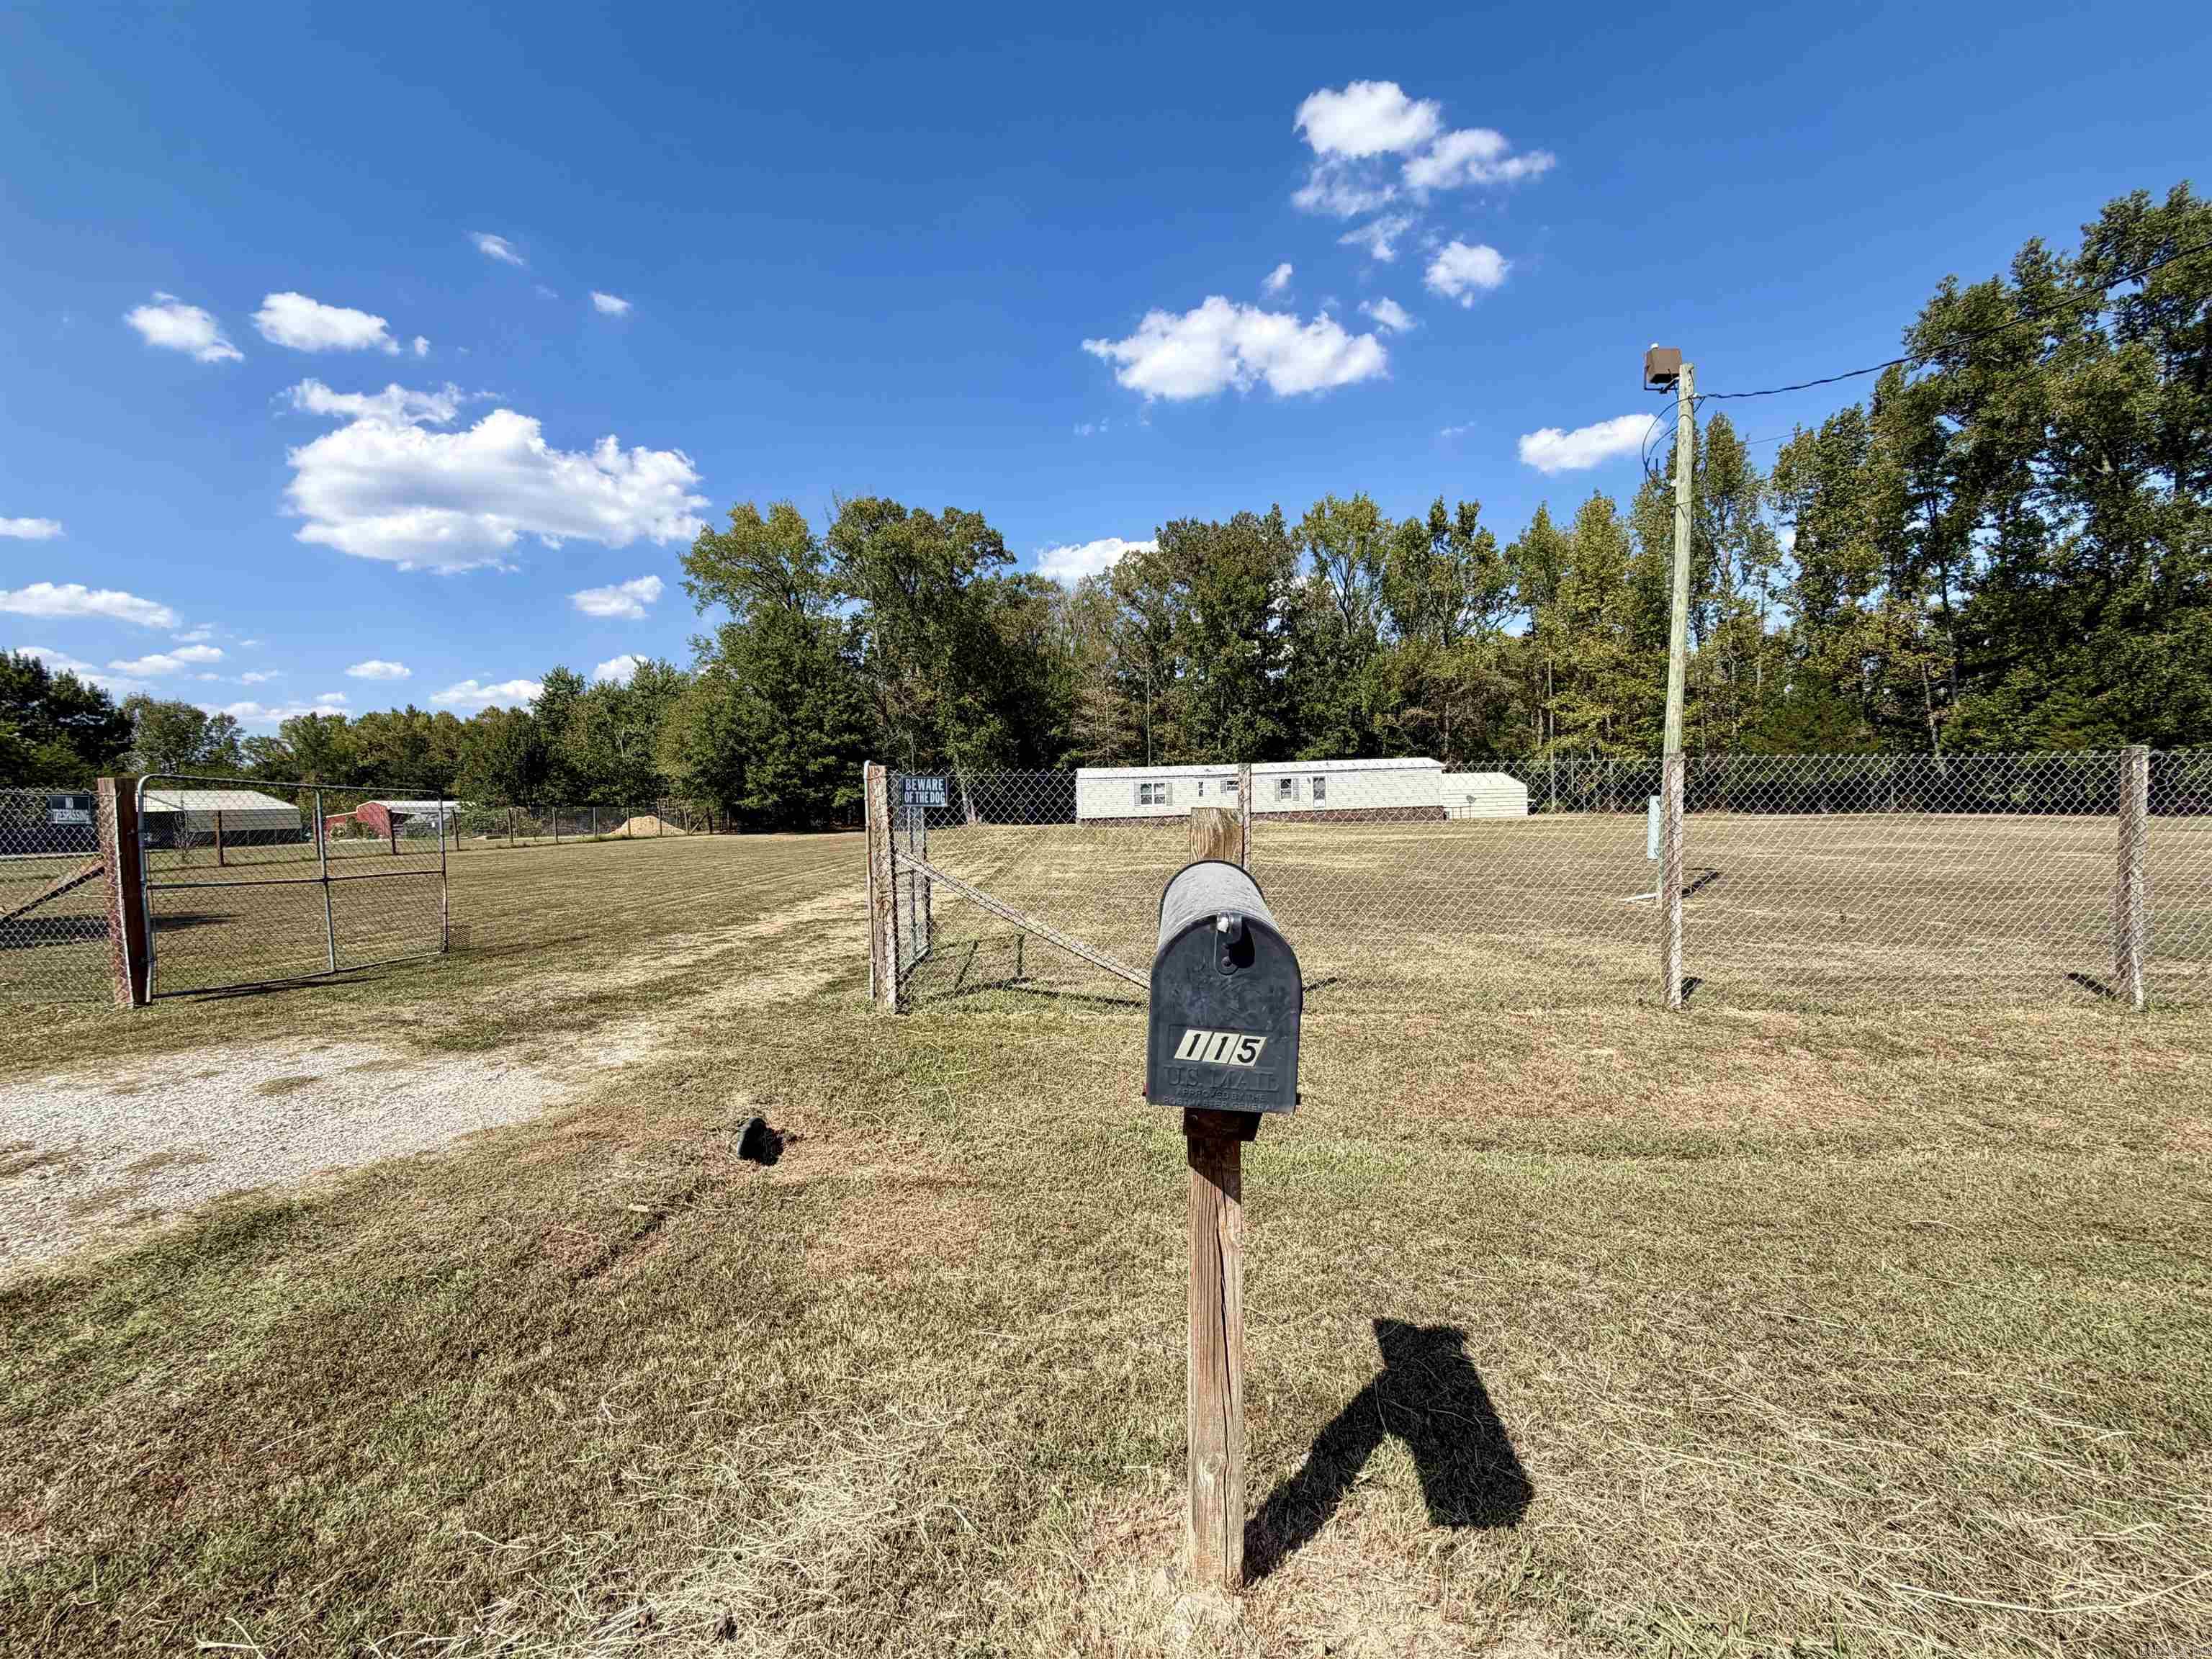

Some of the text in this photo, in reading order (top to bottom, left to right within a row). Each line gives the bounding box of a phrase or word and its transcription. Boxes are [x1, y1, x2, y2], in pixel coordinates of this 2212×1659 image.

[905, 778, 944, 791] BEWARE
[904, 792, 945, 803] OF THE DOG
[1187, 1034, 1260, 1064] 115
